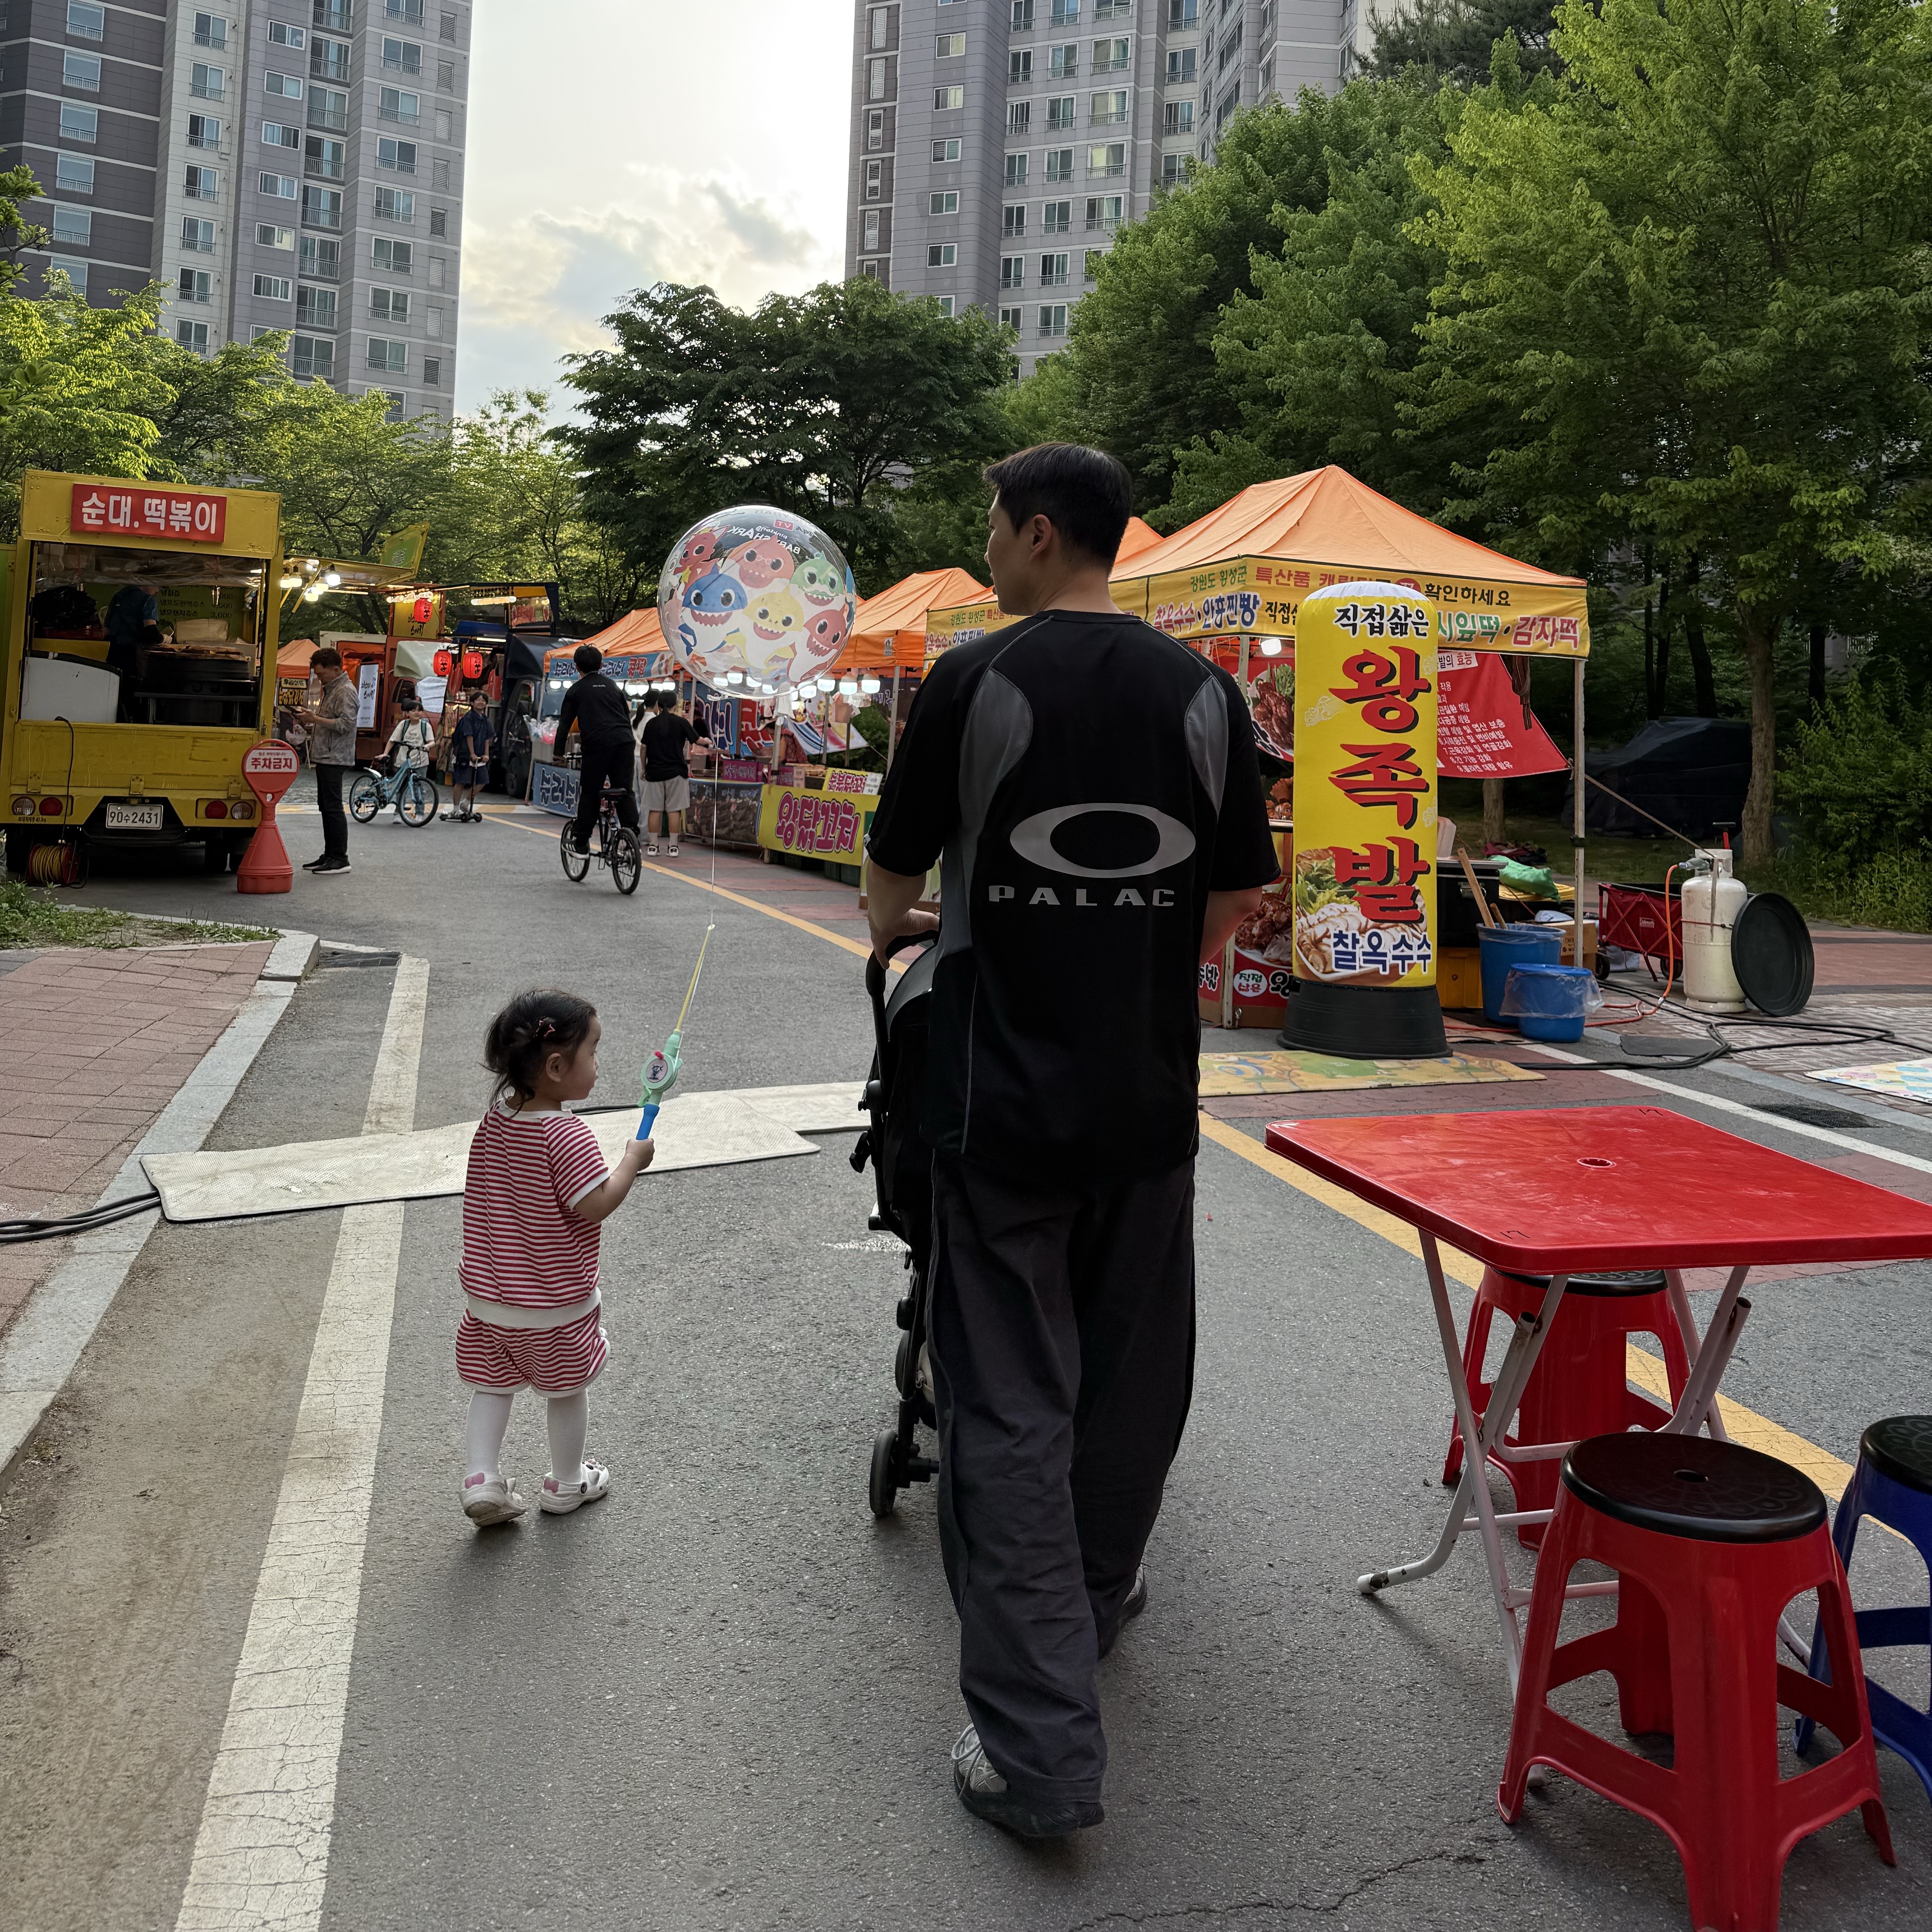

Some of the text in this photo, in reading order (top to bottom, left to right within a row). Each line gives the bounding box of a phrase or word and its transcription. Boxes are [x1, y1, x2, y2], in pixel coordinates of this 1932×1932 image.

[144, 498, 217, 534] 떡볶이
[1191, 572, 1216, 592] 강원도
[1219, 566, 1247, 587] 횡성군
[1256, 566, 1310, 589] 특산품
[1425, 582, 1511, 607] 확인하세요
[951, 613, 966, 626] 강원도
[1202, 593, 1260, 629] 안흥찐빵
[1513, 616, 1579, 649] 감자떡
[1438, 654, 1454, 669] 발의
[1438, 716, 1457, 726] 다공증
[1471, 722, 1488, 733] 엽산
[1489, 718, 1505, 729] 보충
[251, 758, 292, 769] 주차금지
[1476, 754, 1493, 763] 강화
[1328, 645, 1431, 924] 왕족발
[775, 791, 861, 853] 왕닭꼬치
[1332, 930, 1432, 974] 찰옥수수
[1239, 971, 1262, 984] 직접
